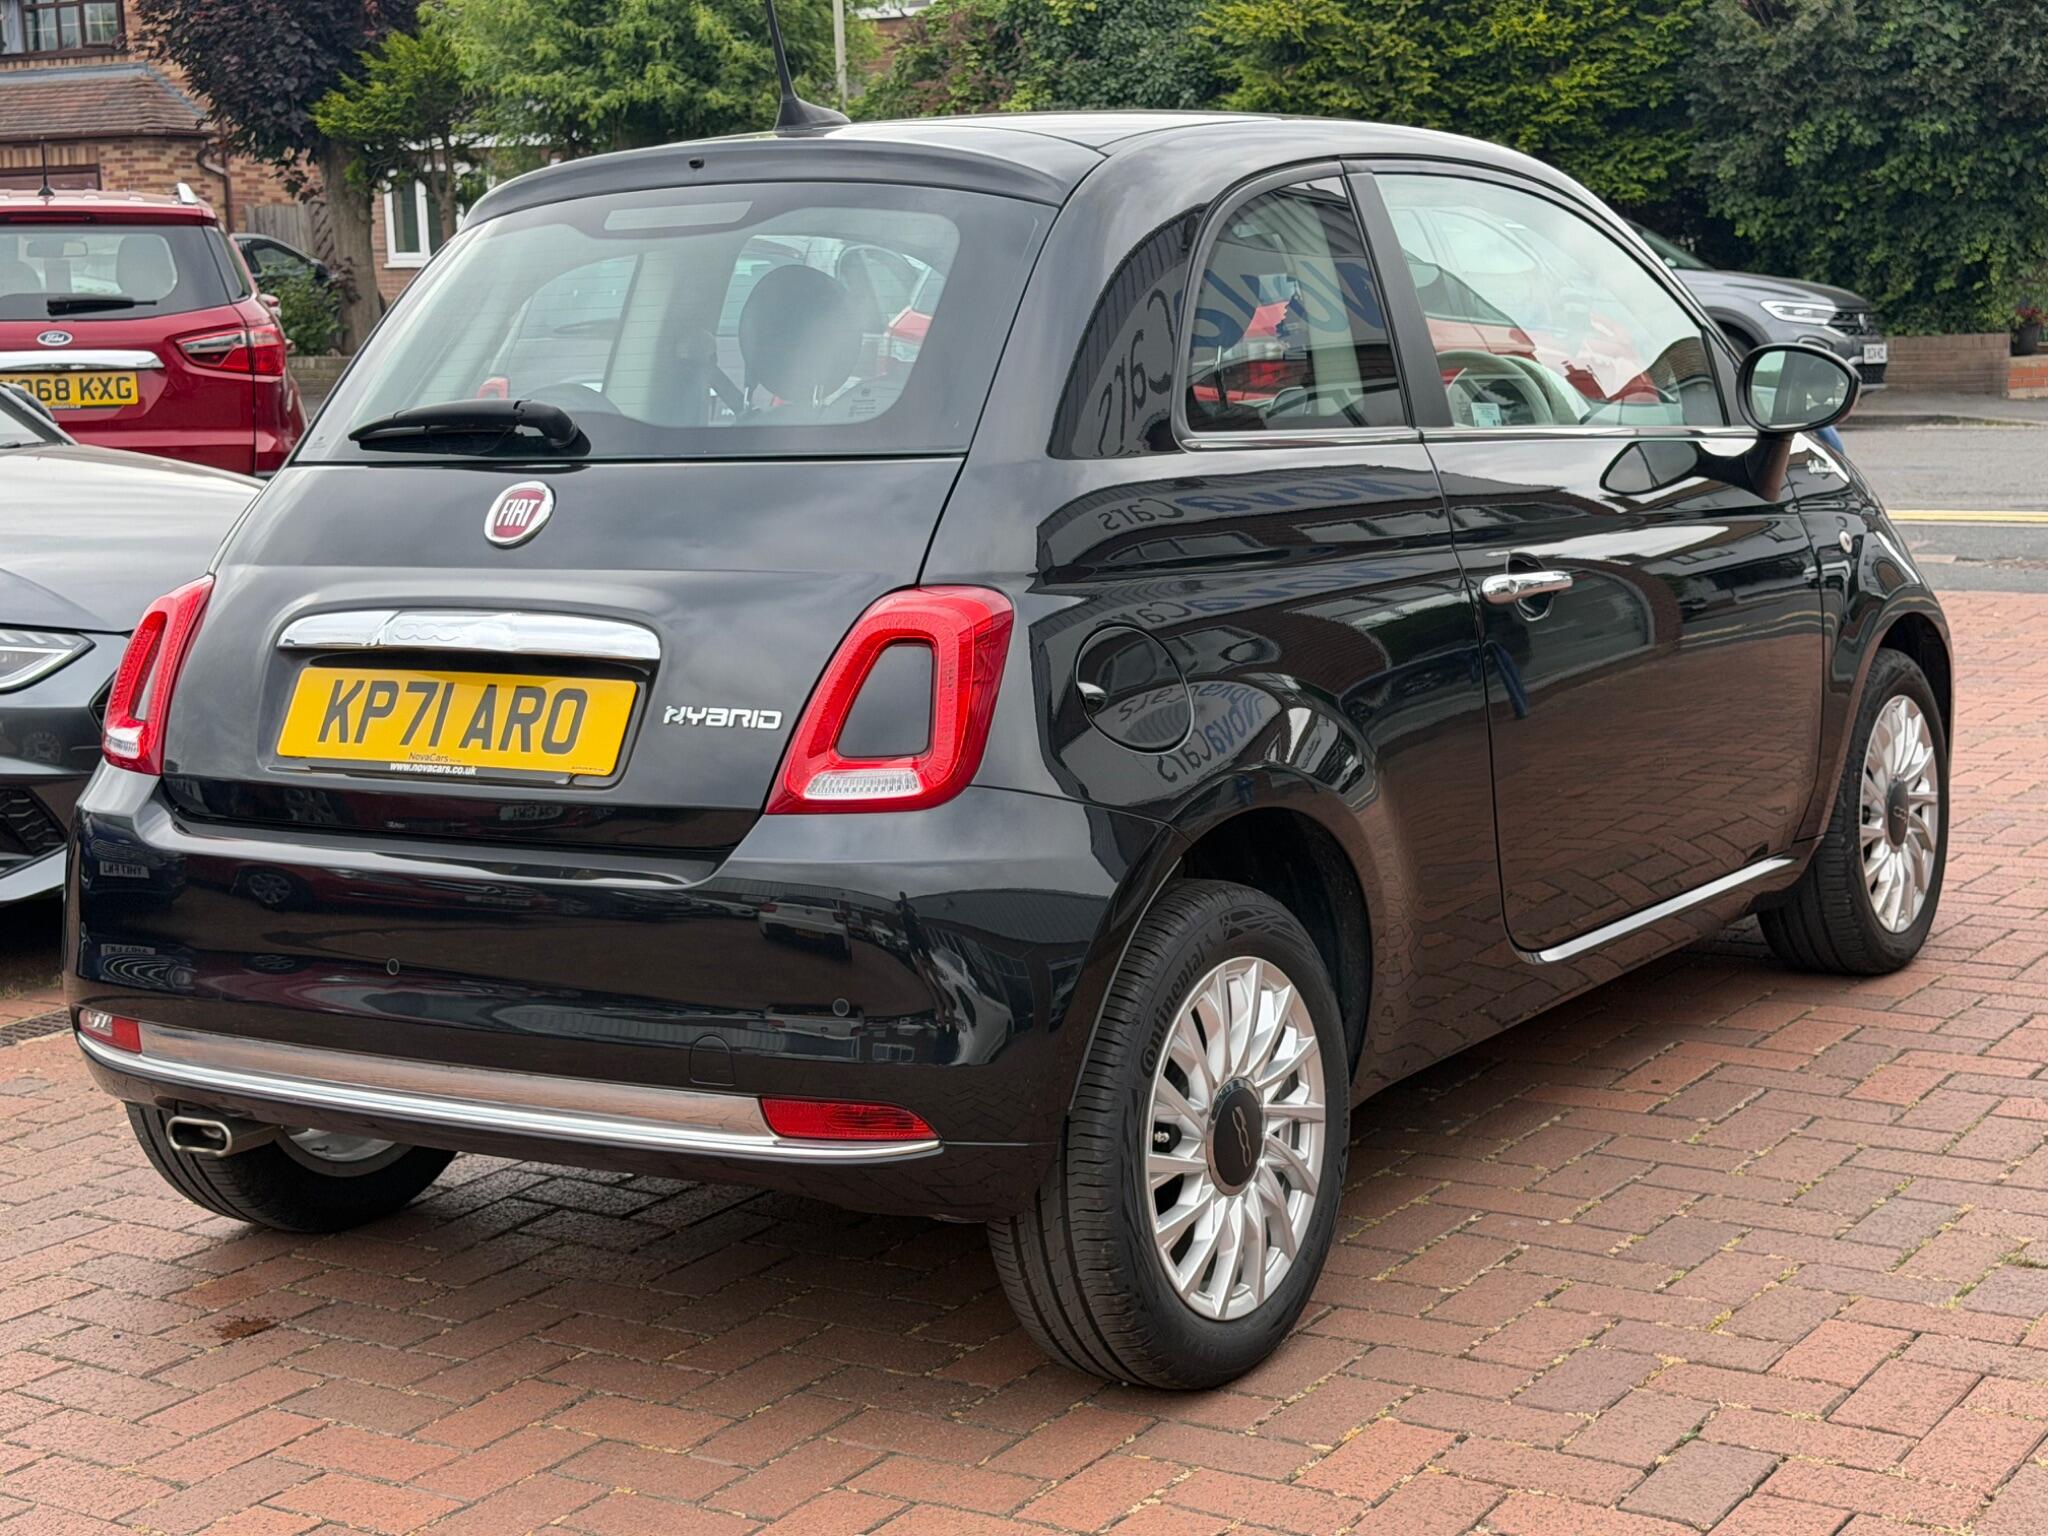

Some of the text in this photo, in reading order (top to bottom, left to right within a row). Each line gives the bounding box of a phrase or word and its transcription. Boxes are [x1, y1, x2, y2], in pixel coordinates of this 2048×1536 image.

[79, 376, 132, 401] KXG
[495, 498, 541, 527] FIAT
[316, 679, 589, 755] KP71 ARO
[663, 705, 782, 729] HYBRID
[389, 762, 478, 775] www.novacars.co.uk
[408, 751, 449, 762] NovaCars
[1140, 940, 1207, 1078] Continental
